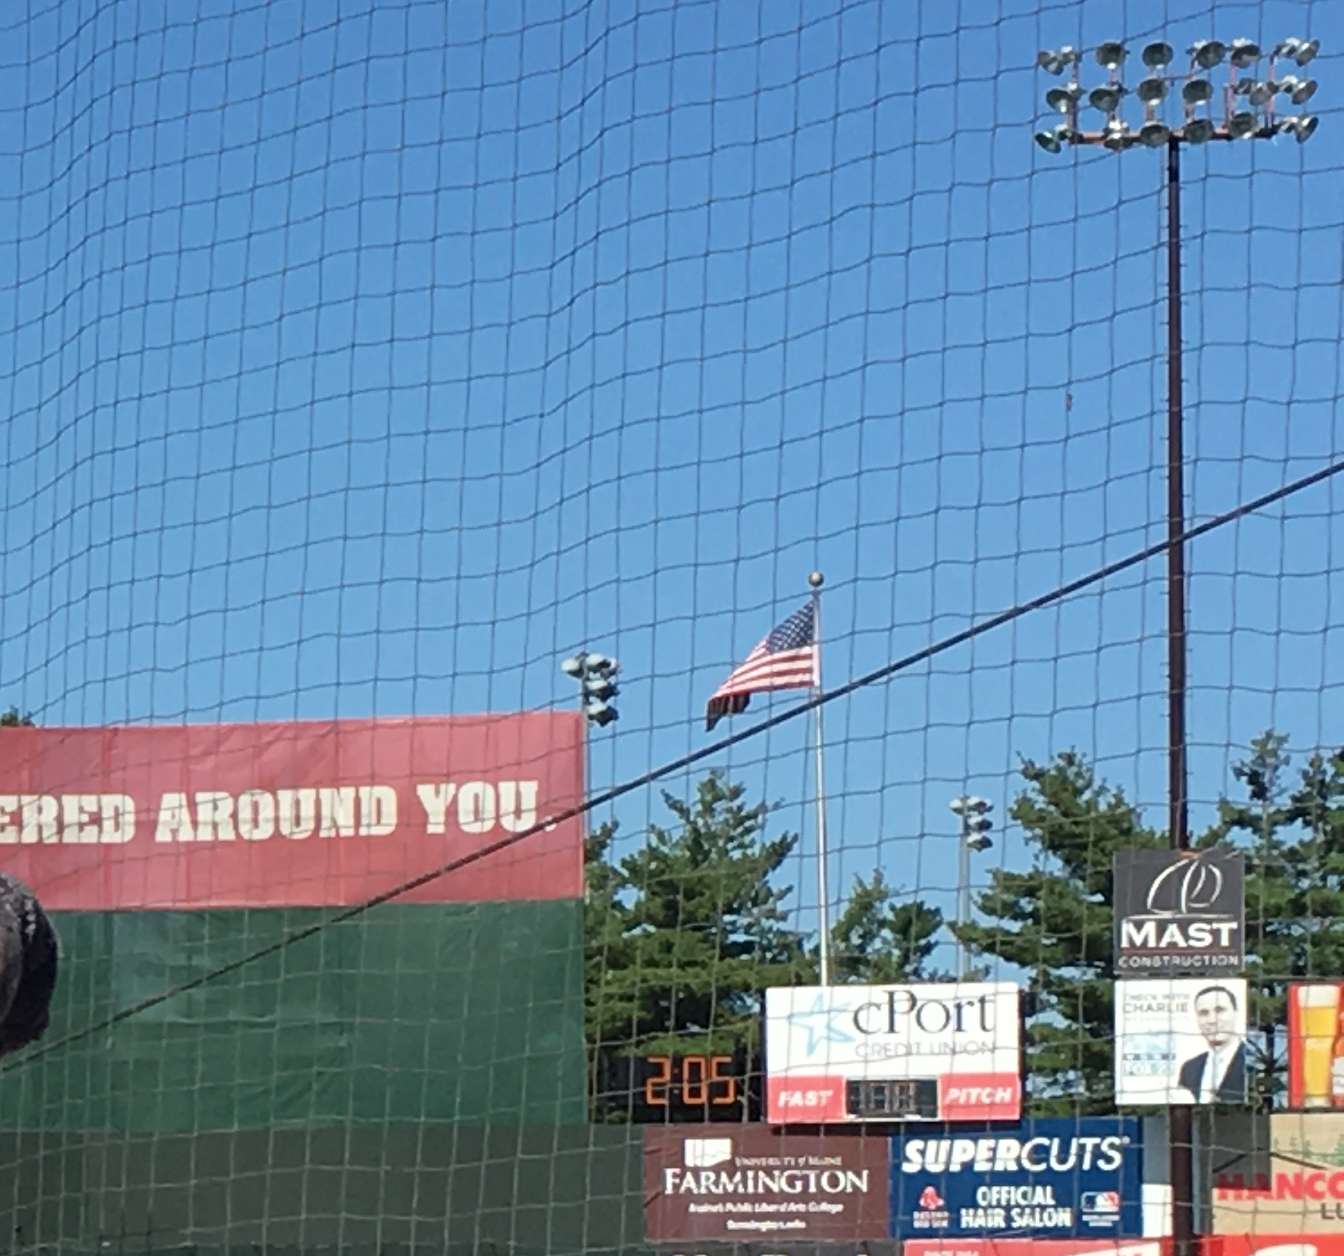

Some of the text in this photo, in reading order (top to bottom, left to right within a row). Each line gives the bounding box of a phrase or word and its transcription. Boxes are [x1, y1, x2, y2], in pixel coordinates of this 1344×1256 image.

[154, 785, 399, 842] AROUND
[1120, 920, 1239, 948] MAST
[1118, 954, 1240, 969] CONSTRUCTION
[852, 989, 996, 1036] cPort
[1122, 1002, 1189, 1014] CHARLIE
[855, 1039, 997, 1058] CREDIT UNION
[646, 1055, 736, 1106] 2:05
[777, 1089, 833, 1108] FAST
[945, 1087, 1013, 1105] PITCH
[663, 1167, 870, 1195] FARMINGTON
[975, 1185, 1057, 1207] OFFICIAL
[960, 1207, 1007, 1229] HAIR
[1010, 1207, 1073, 1229] SALON
